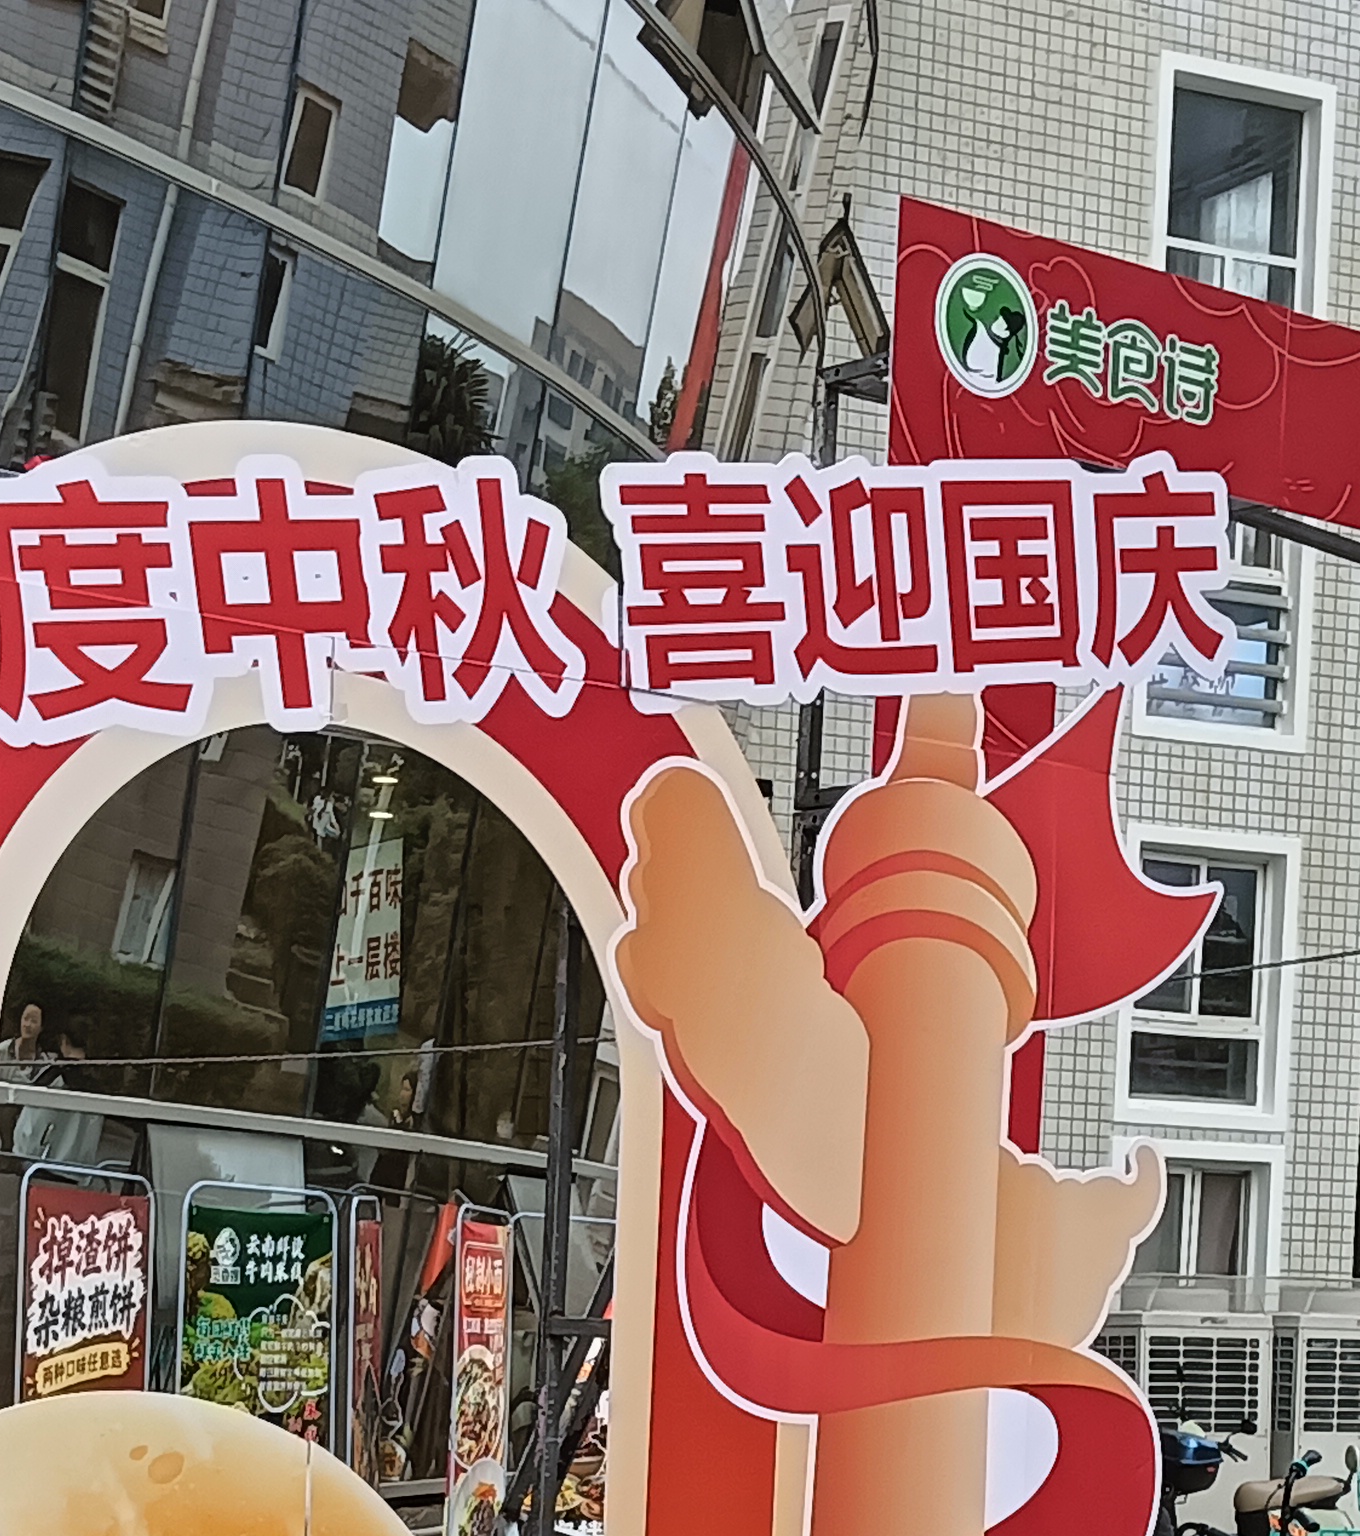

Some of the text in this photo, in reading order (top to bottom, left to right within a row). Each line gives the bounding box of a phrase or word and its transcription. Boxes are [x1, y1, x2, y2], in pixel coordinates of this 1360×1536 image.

[1044, 300, 1219, 426] 美食诗
[620, 470, 1242, 690] 喜迎国庆
[39, 1217, 135, 1292] 掉渣饼
[33, 1280, 137, 1348] 杂粮煎饼
[42, 1348, 123, 1389] 两种口味任意选
